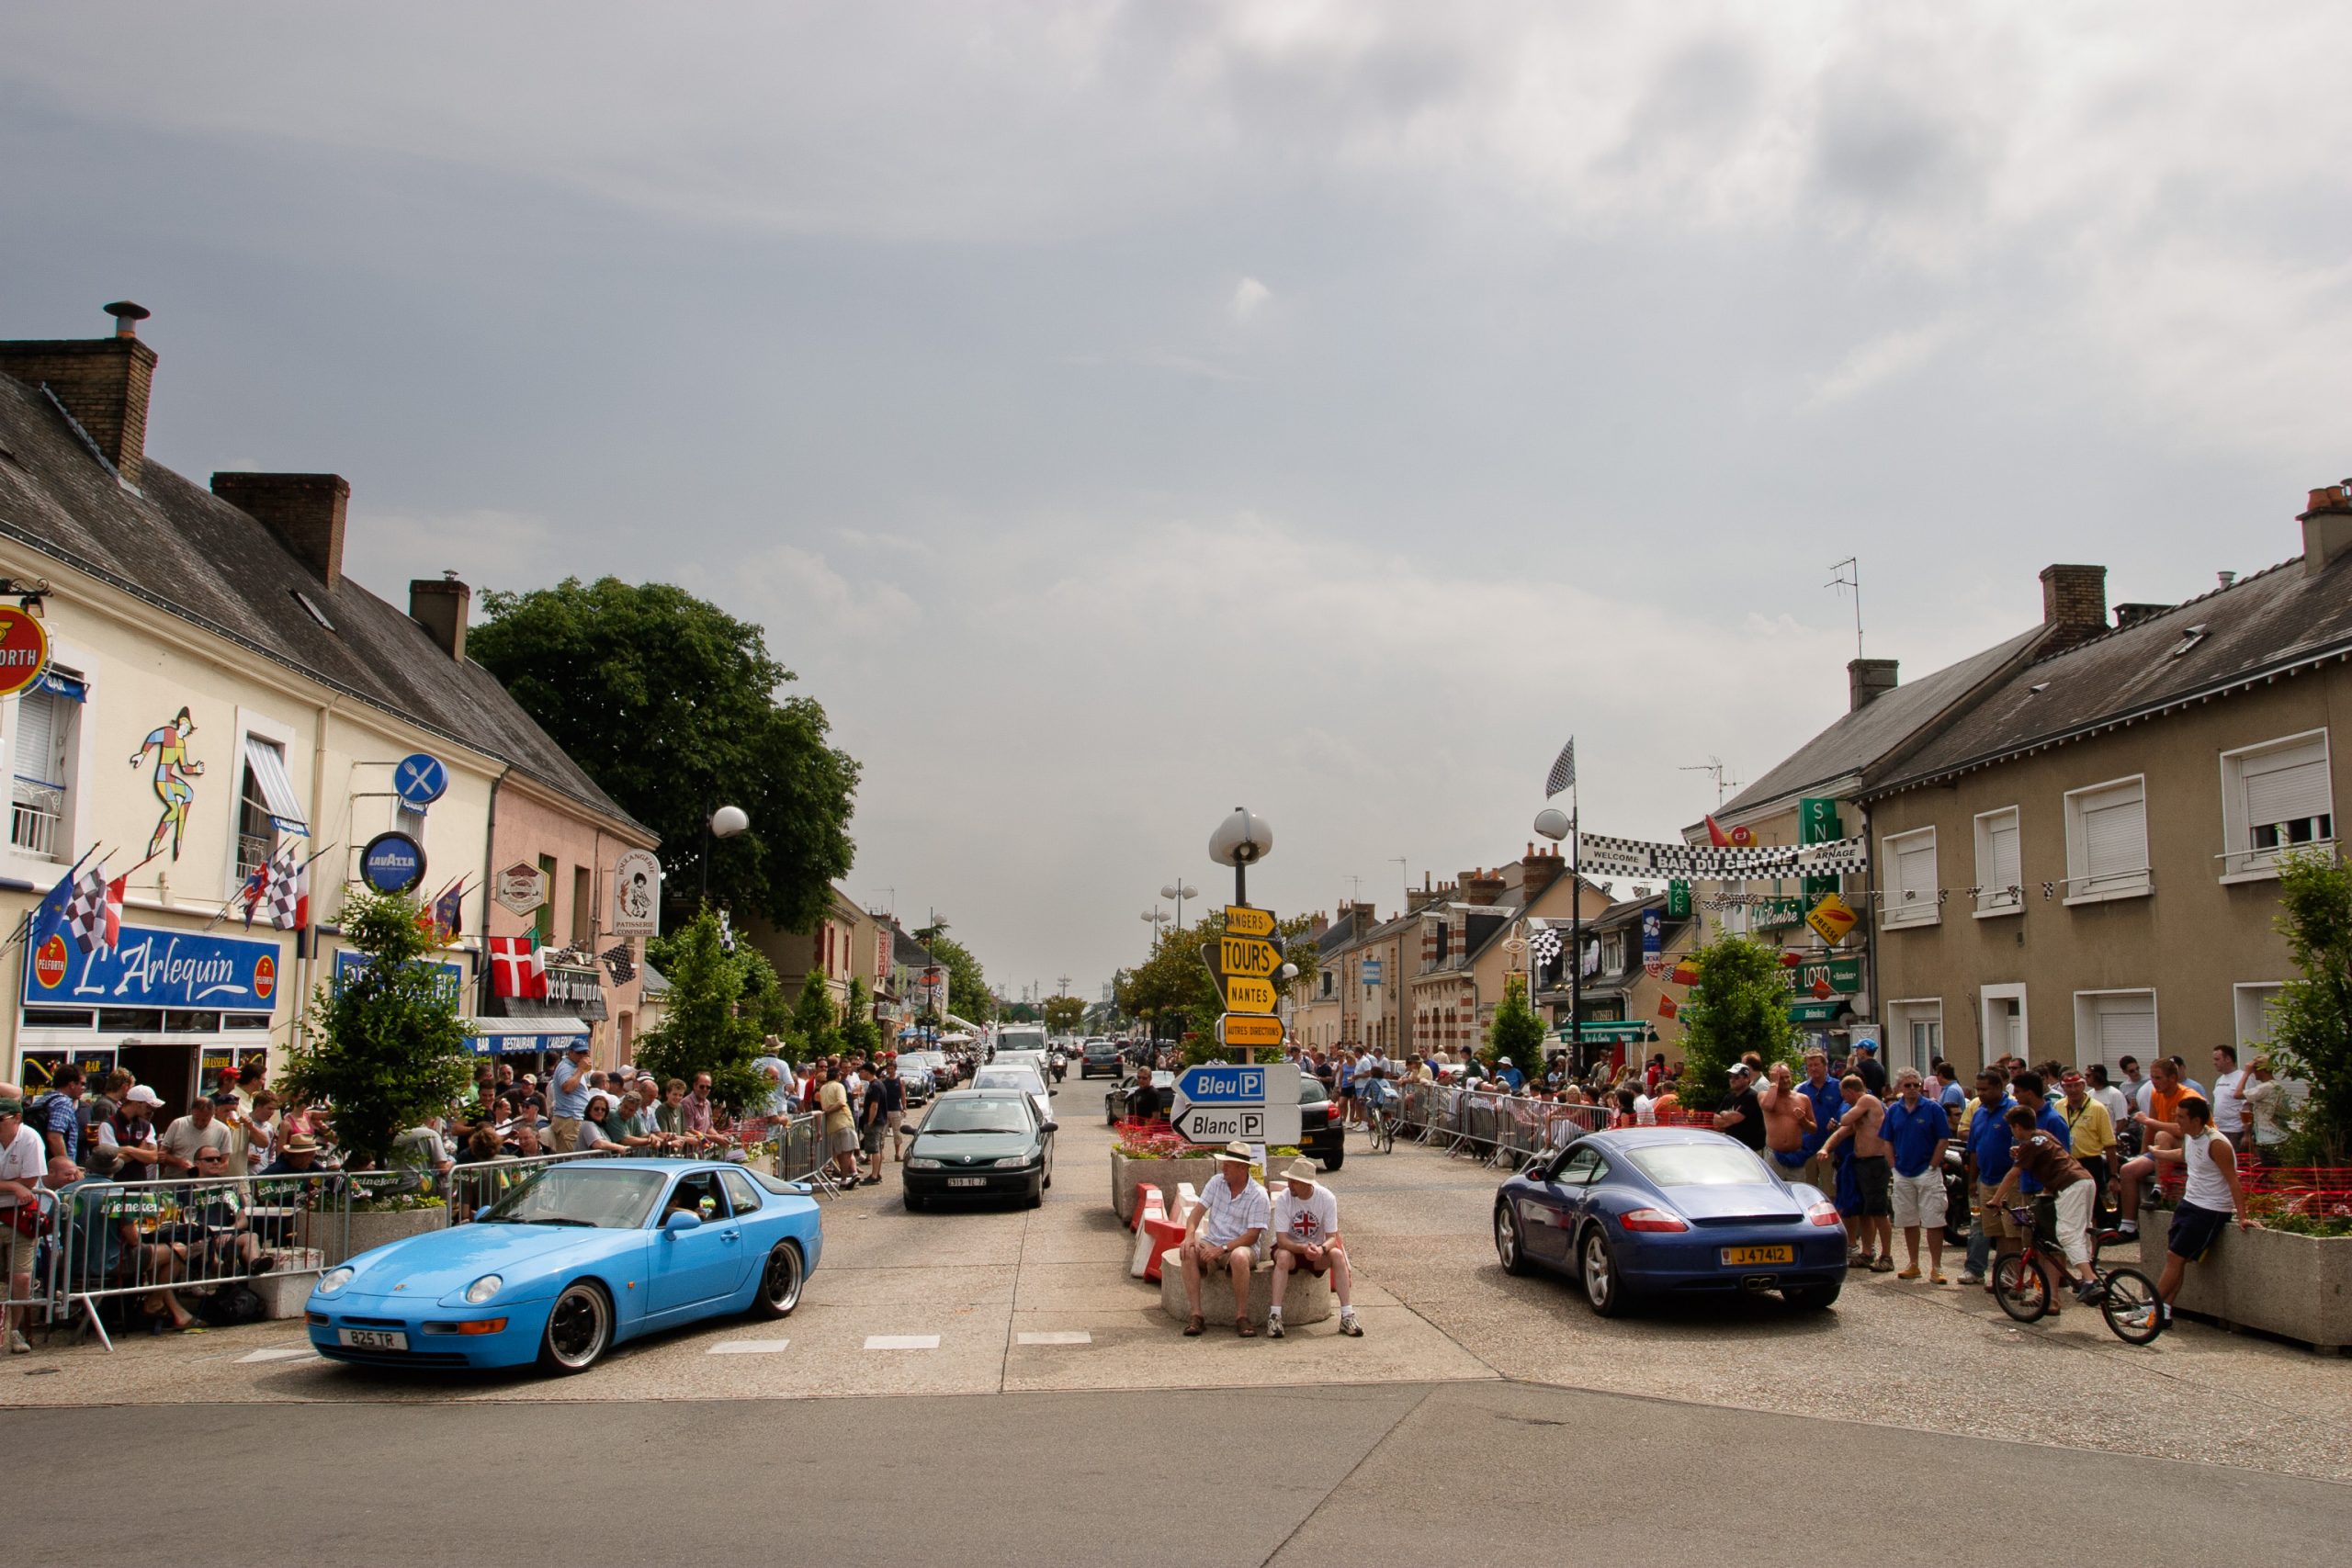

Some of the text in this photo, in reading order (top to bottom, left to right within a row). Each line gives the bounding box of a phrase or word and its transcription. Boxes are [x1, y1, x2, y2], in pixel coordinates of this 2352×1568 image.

[47, 676, 66, 692] BAR
[368, 852, 415, 867] LAVAZZA
[1594, 851, 1639, 863] WELCOME
[1657, 855, 1792, 871] BAR DU CENTRE
[1815, 848, 1856, 862] ARNAGE
[618, 852, 655, 875] BOULANGERIE
[1229, 913, 1263, 930] ANGERS
[1766, 904, 1798, 926] Centre
[1811, 914, 1839, 942] PRESSE
[38, 958, 64, 971] PELFORTH
[1224, 941, 1270, 972] TOURS
[74, 936, 233, 1002] L'Arlequin
[1804, 965, 1830, 988] LOTO
[571, 975, 602, 1010] mignon
[1231, 987, 1268, 1003] NANTES
[1227, 1025, 1279, 1036] AUTRES DIRECTIONS
[477, 1036, 490, 1052] BAR
[502, 1036, 537, 1051] RESTAURANT
[85, 1060, 100, 1073] BAR
[1196, 1075, 1259, 1094] Bleu P
[1193, 1115, 1259, 1134] Blanc P
[1736, 1248, 1785, 1262] J 47412
[377, 1333, 394, 1347] TR
